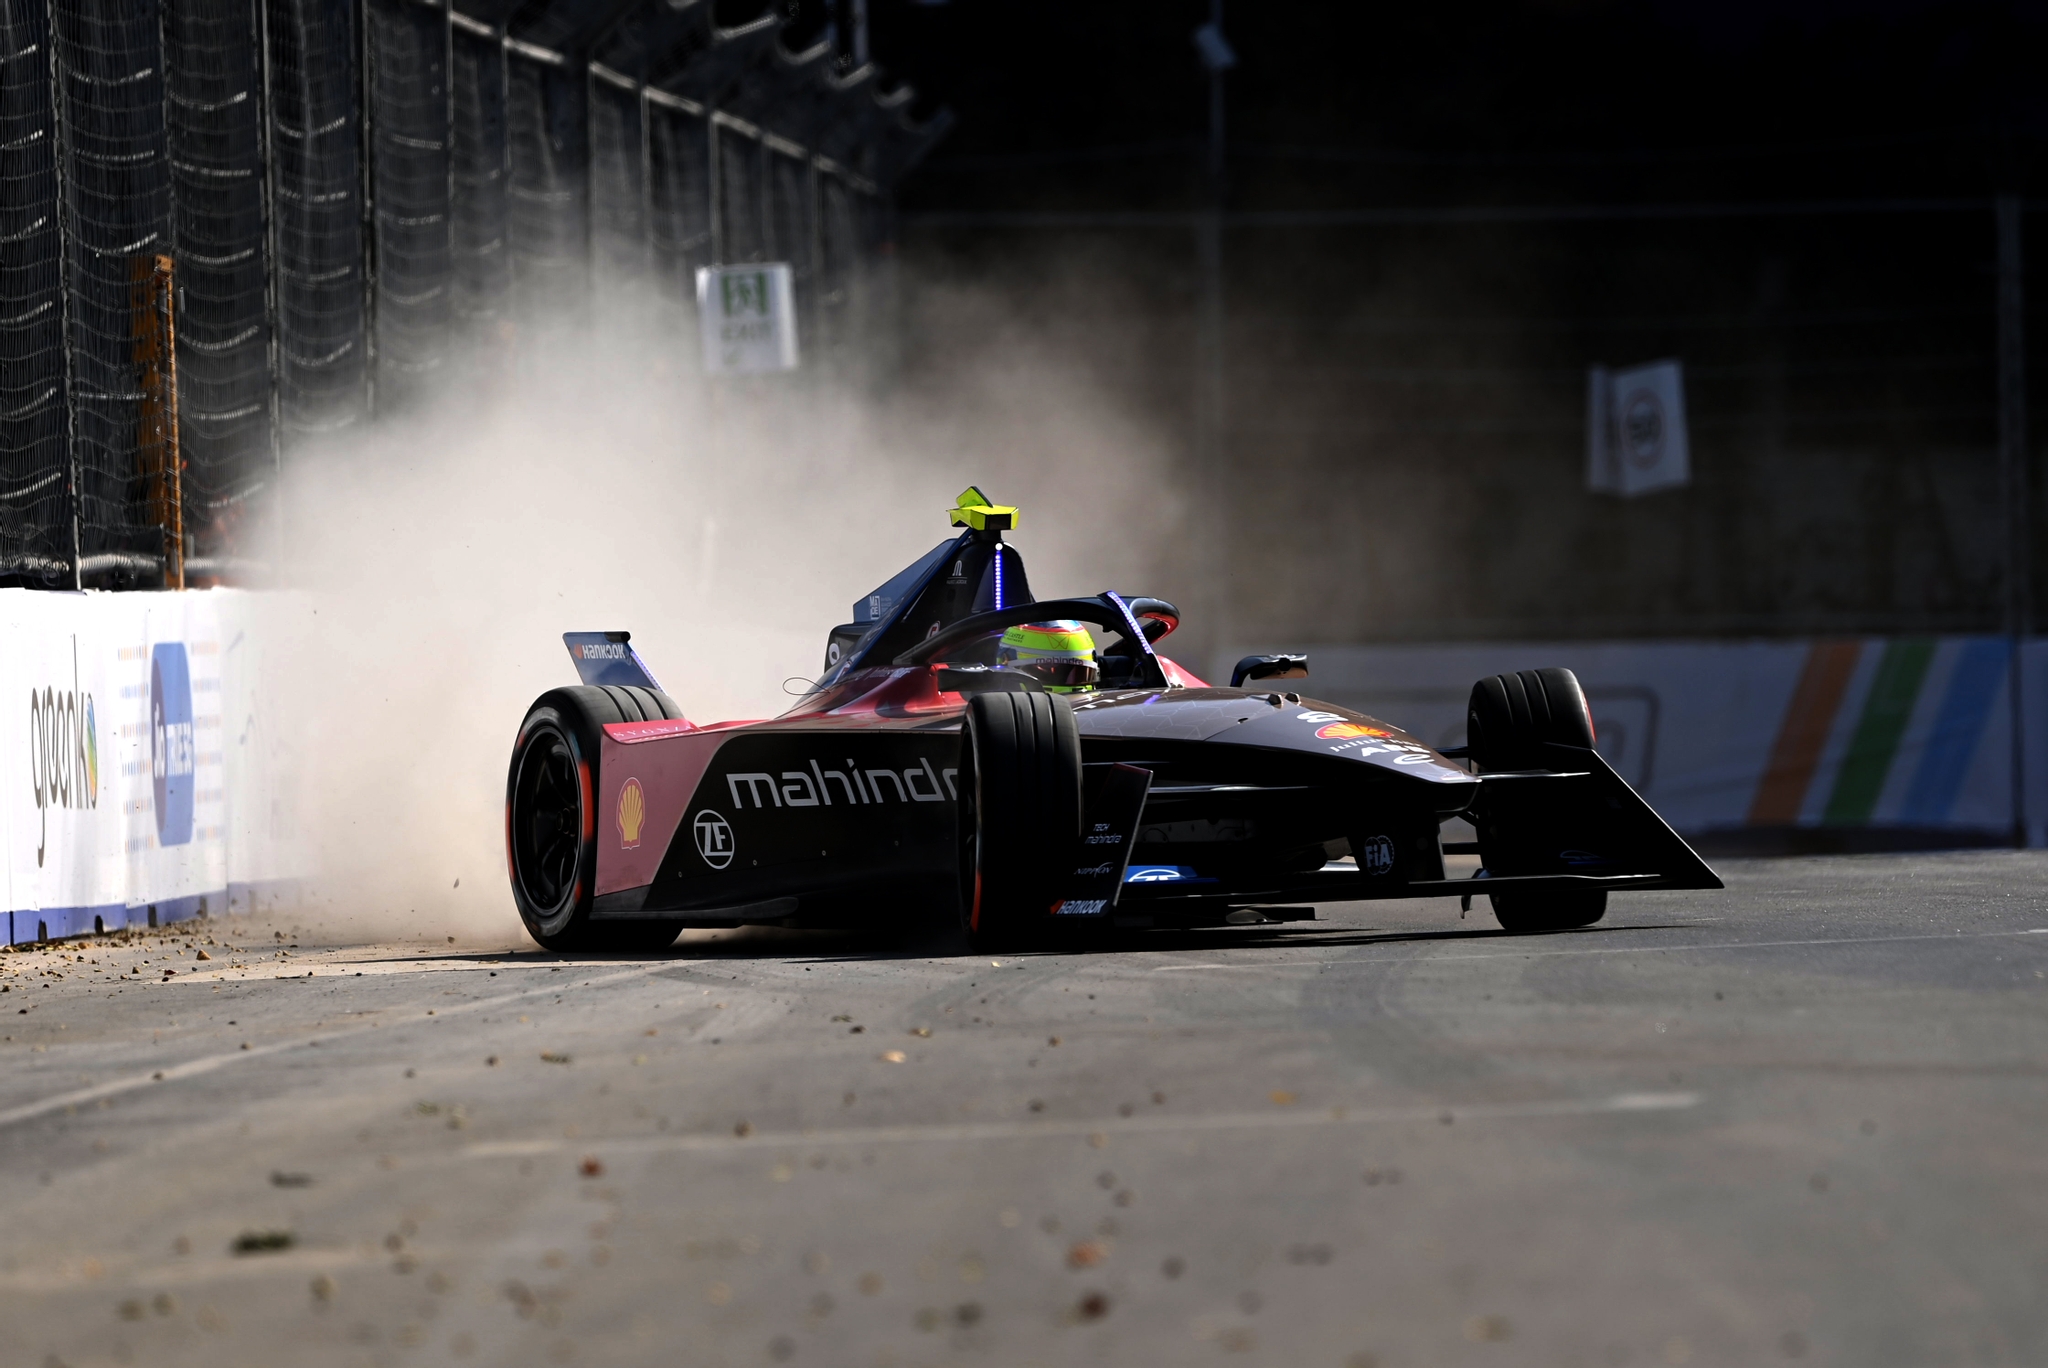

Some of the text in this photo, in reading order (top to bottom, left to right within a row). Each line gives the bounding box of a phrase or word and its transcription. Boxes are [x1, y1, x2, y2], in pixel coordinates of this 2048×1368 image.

[726, 757, 958, 809] mahindr
[1093, 823, 1110, 831] TECH
[696, 822, 732, 856] ZF
[1085, 833, 1122, 844] mahindra
